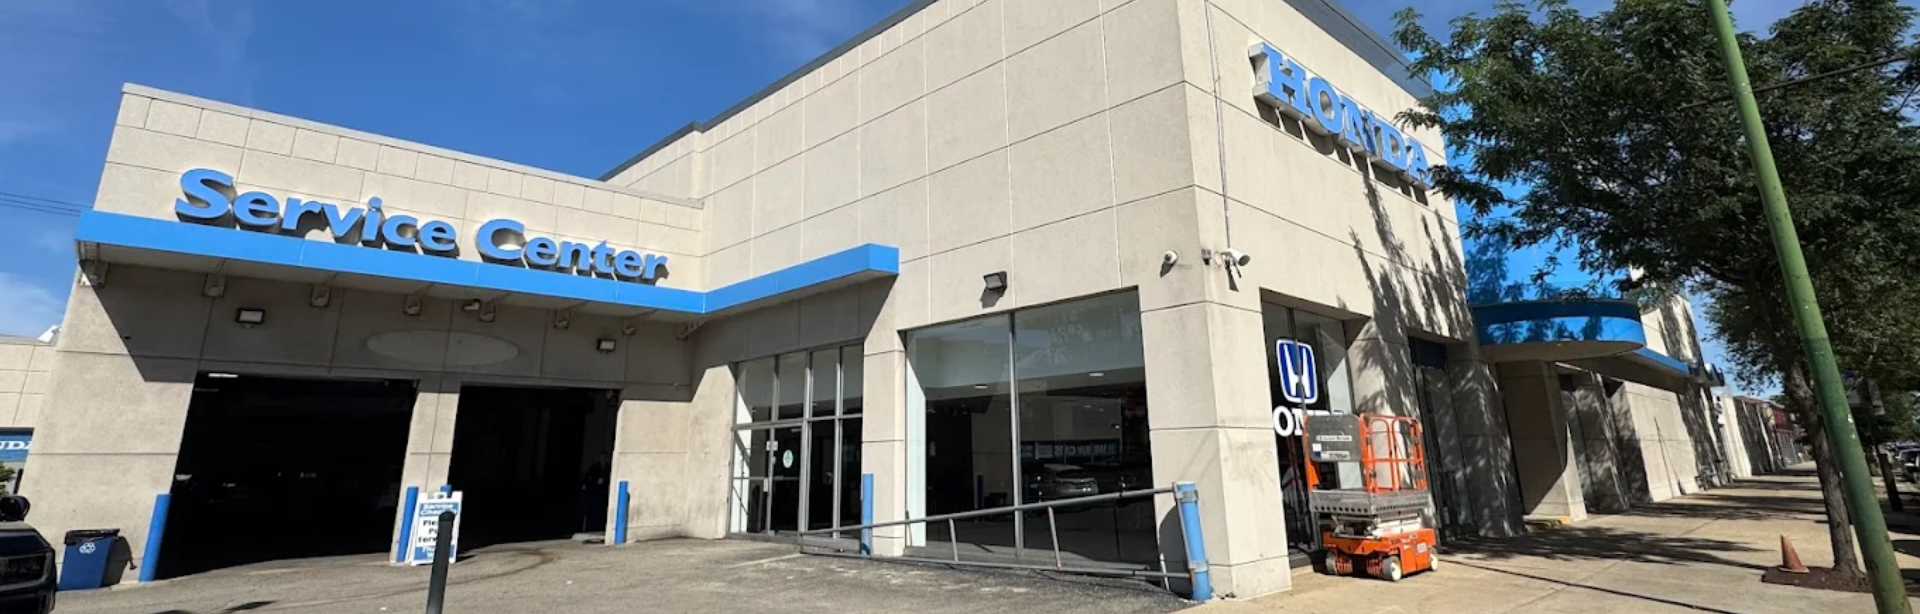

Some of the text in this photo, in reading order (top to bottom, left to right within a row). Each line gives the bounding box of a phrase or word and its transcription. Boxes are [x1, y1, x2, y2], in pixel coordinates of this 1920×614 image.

[1249, 42, 1434, 191] HONDA
[175, 168, 669, 280] Service Center
